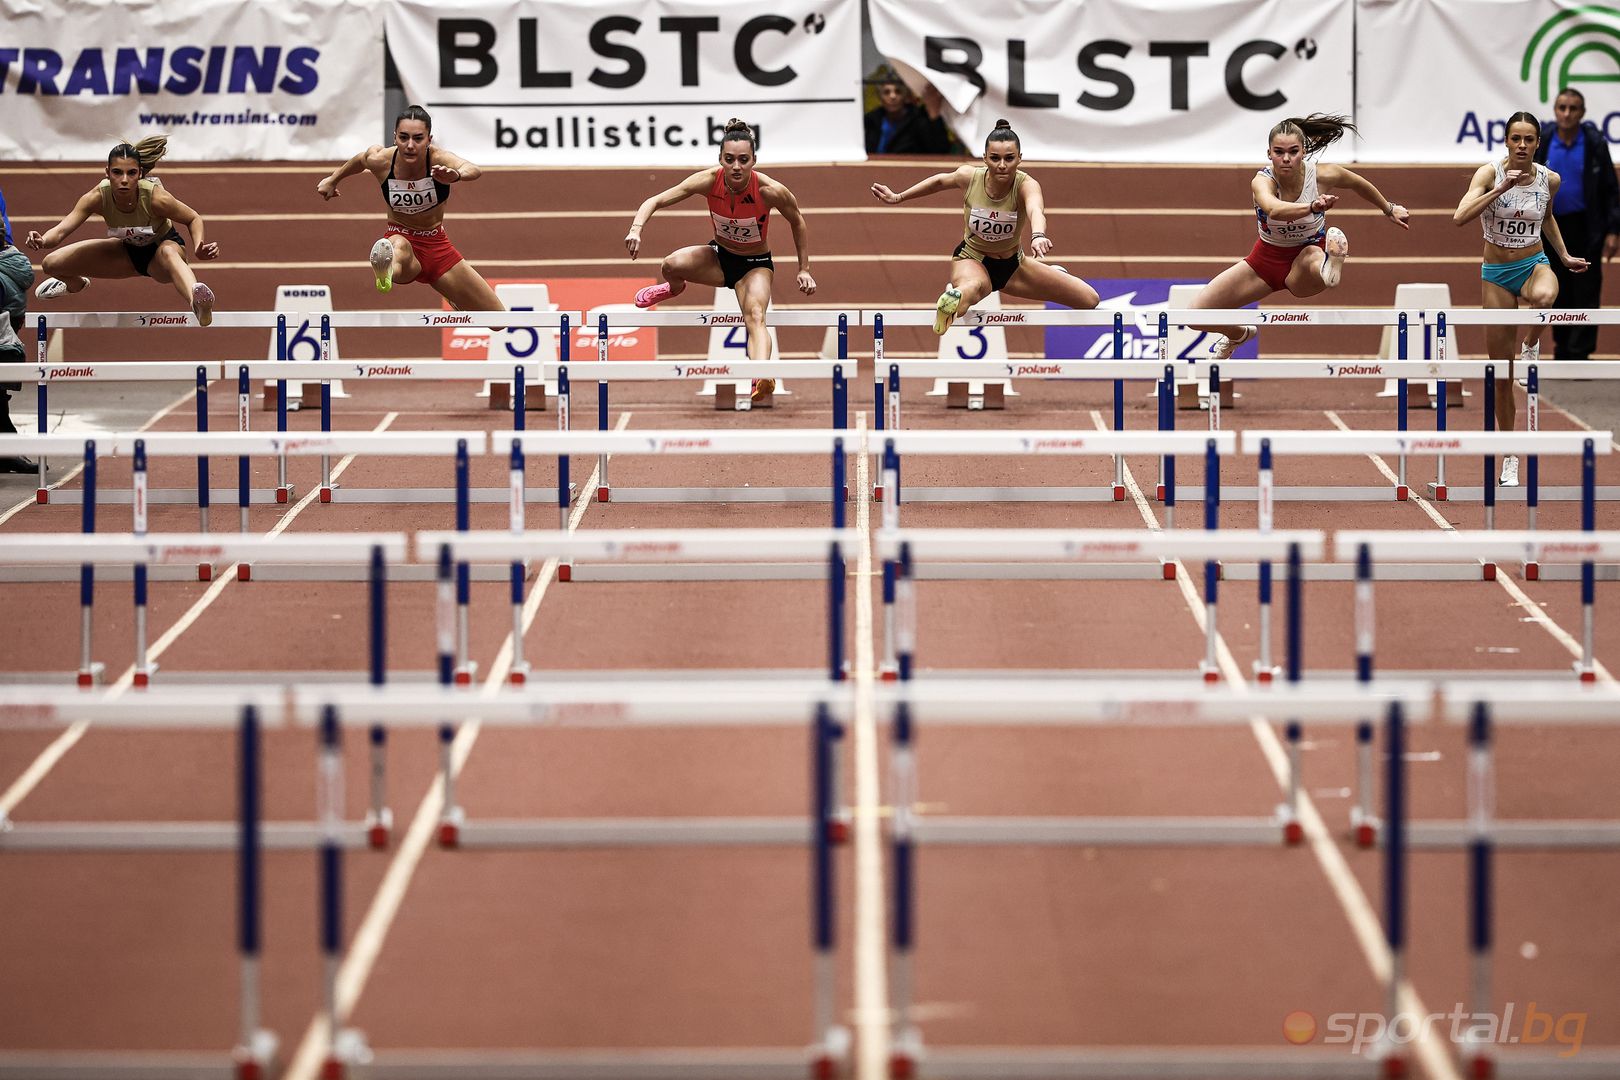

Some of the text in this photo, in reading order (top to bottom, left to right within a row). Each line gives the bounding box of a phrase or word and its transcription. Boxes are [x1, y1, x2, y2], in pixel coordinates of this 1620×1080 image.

[437, 14, 799, 89] BLSTC
[0, 46, 320, 97] TRANSINS
[924, 35, 1289, 111] BLSTC
[139, 109, 318, 126] www.transins.com
[392, 191, 433, 207] 2901
[720, 224, 752, 237] 272
[972, 219, 1014, 235] 1200
[1498, 220, 1536, 236] 1501
[149, 315, 188, 326] polanik
[432, 314, 472, 326] polanik
[710, 314, 744, 326] polani
[985, 313, 1025, 325] polanik
[1269, 313, 1310, 325] polanik
[1547, 313, 1590, 325] polanik
[505, 306, 539, 359] 5
[287, 319, 321, 361] 6
[48, 367, 95, 380] polanik
[368, 365, 413, 379] polanik
[685, 365, 731, 379] polanik
[1016, 364, 1063, 378] polanik
[1337, 364, 1383, 378] polanik
